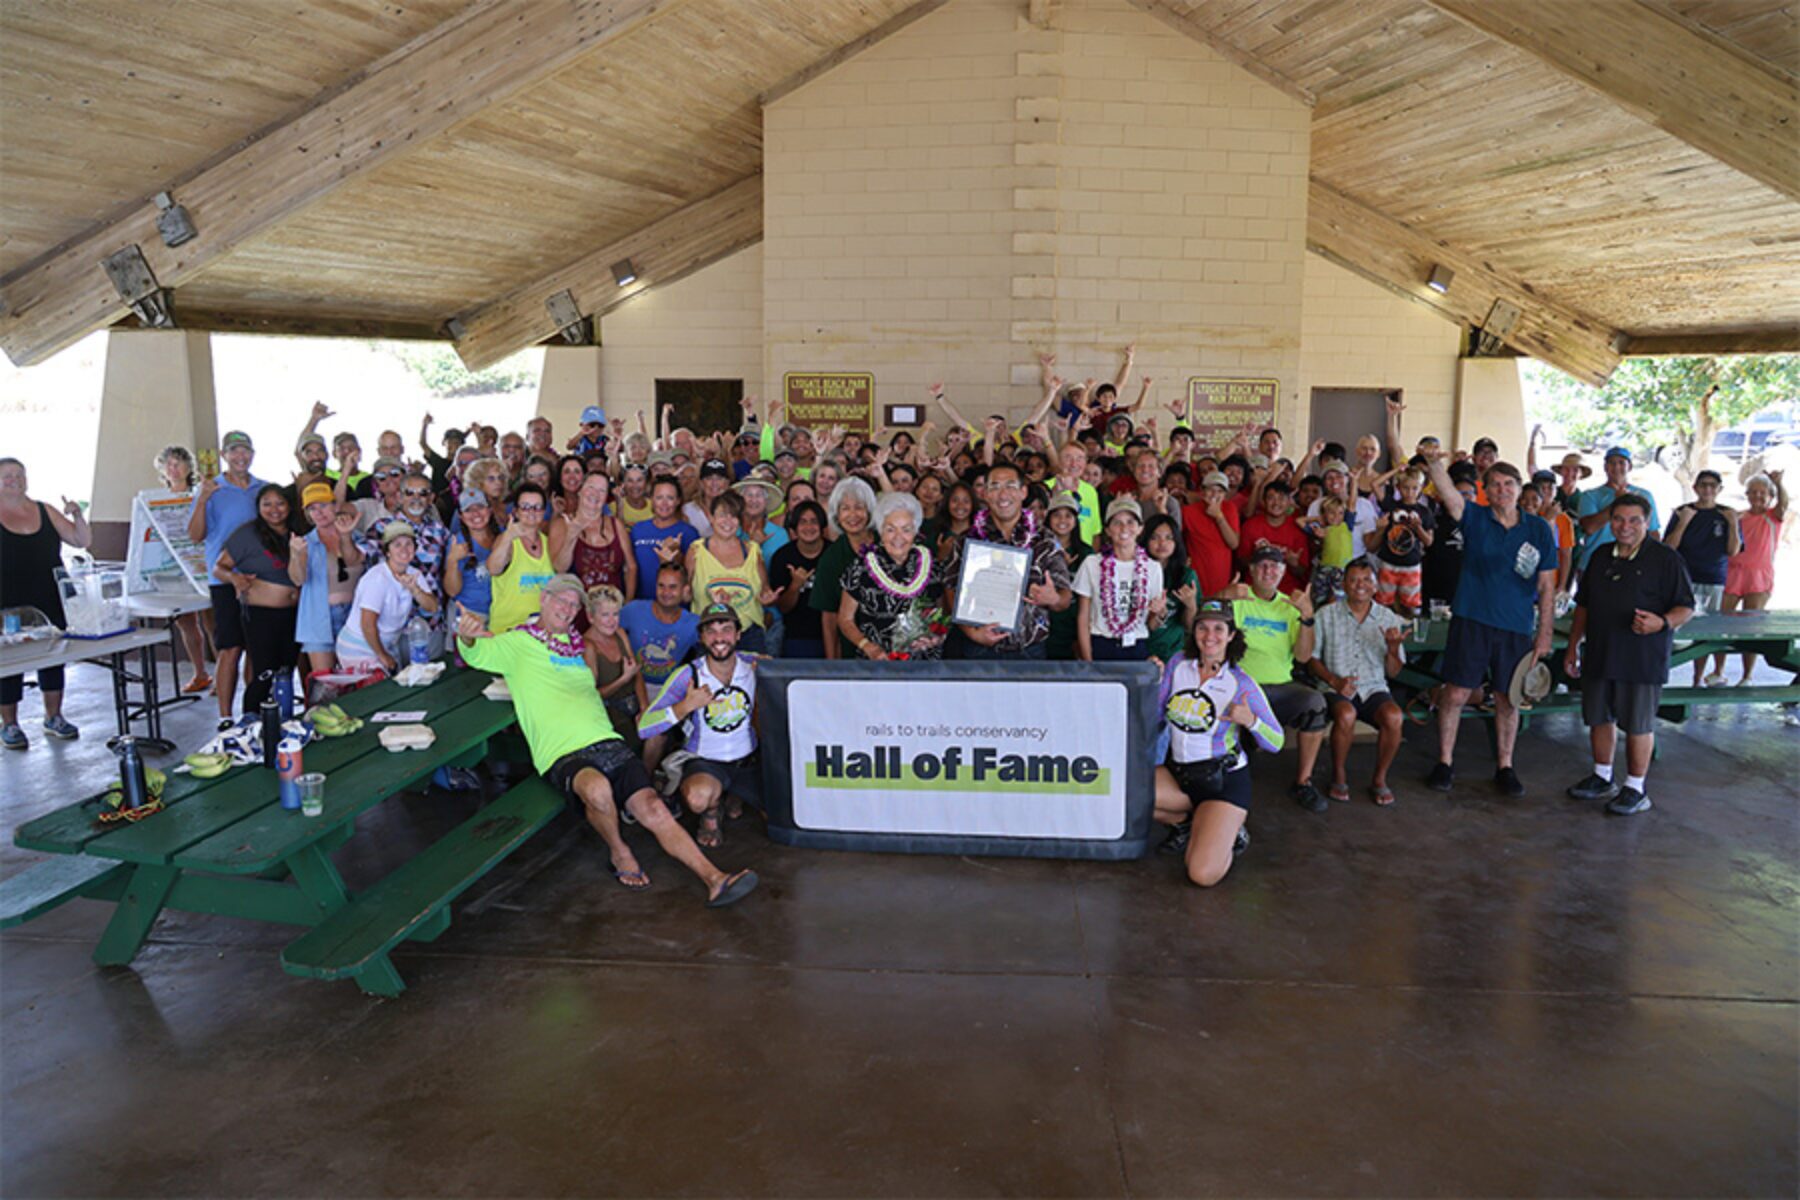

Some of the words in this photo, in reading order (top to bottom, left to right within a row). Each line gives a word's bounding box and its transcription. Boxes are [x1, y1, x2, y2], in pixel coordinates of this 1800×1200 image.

[865, 724, 894, 737] rails
[897, 725, 914, 737] to
[916, 725, 952, 738] trails
[955, 726, 1049, 741] conservancy
[815, 745, 901, 779] Hall
[912, 747, 962, 781] of
[972, 747, 1099, 783] Fame
